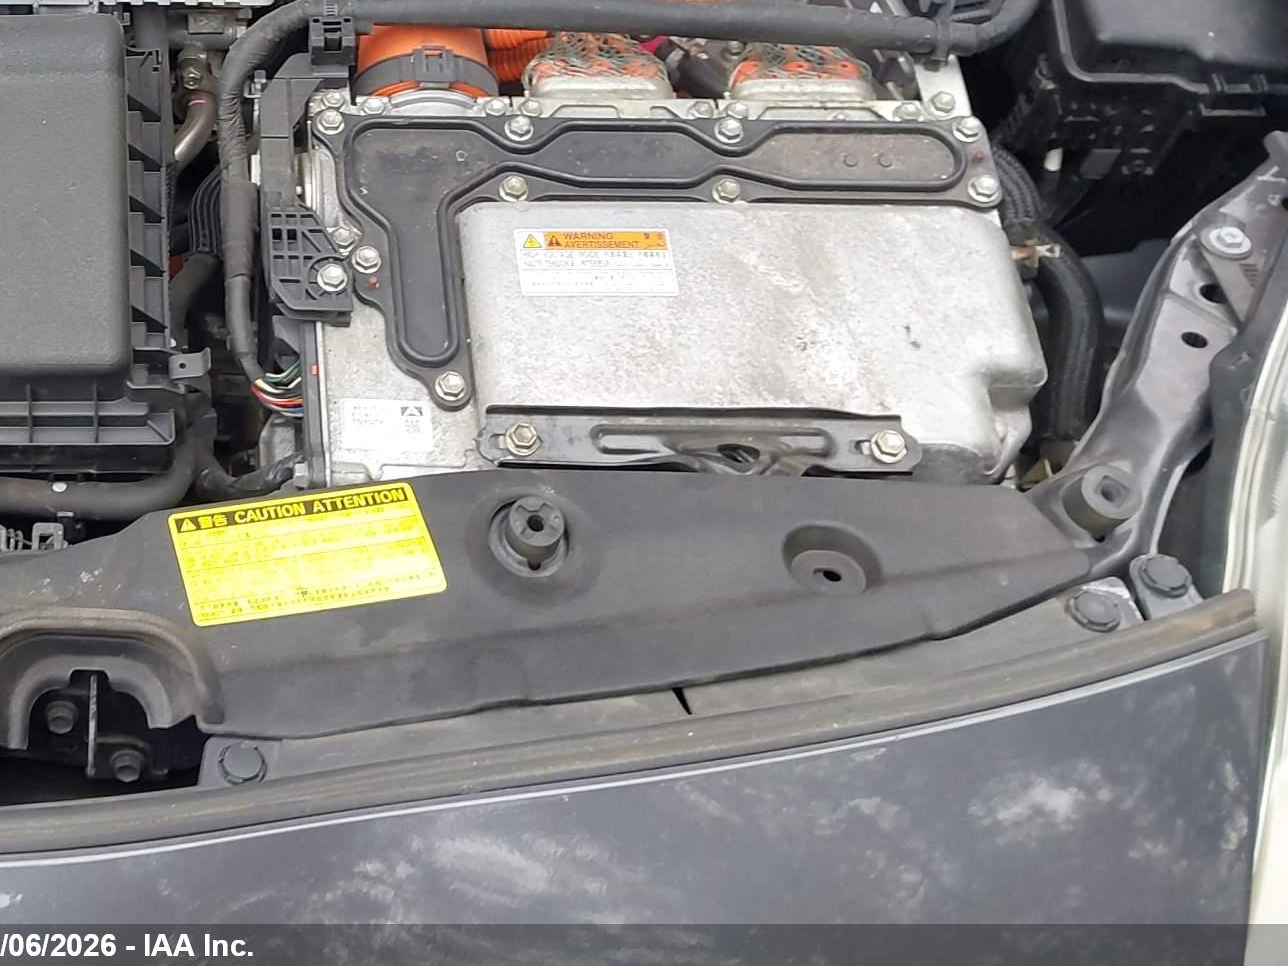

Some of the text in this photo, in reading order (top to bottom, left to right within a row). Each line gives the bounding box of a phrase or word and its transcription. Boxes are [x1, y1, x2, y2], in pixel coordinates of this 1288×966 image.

[562, 232, 614, 240] WARNING
[563, 241, 641, 249] AVERTISSEMENT
[234, 502, 307, 525] CAUTION
[312, 488, 406, 514] ATTENTION
